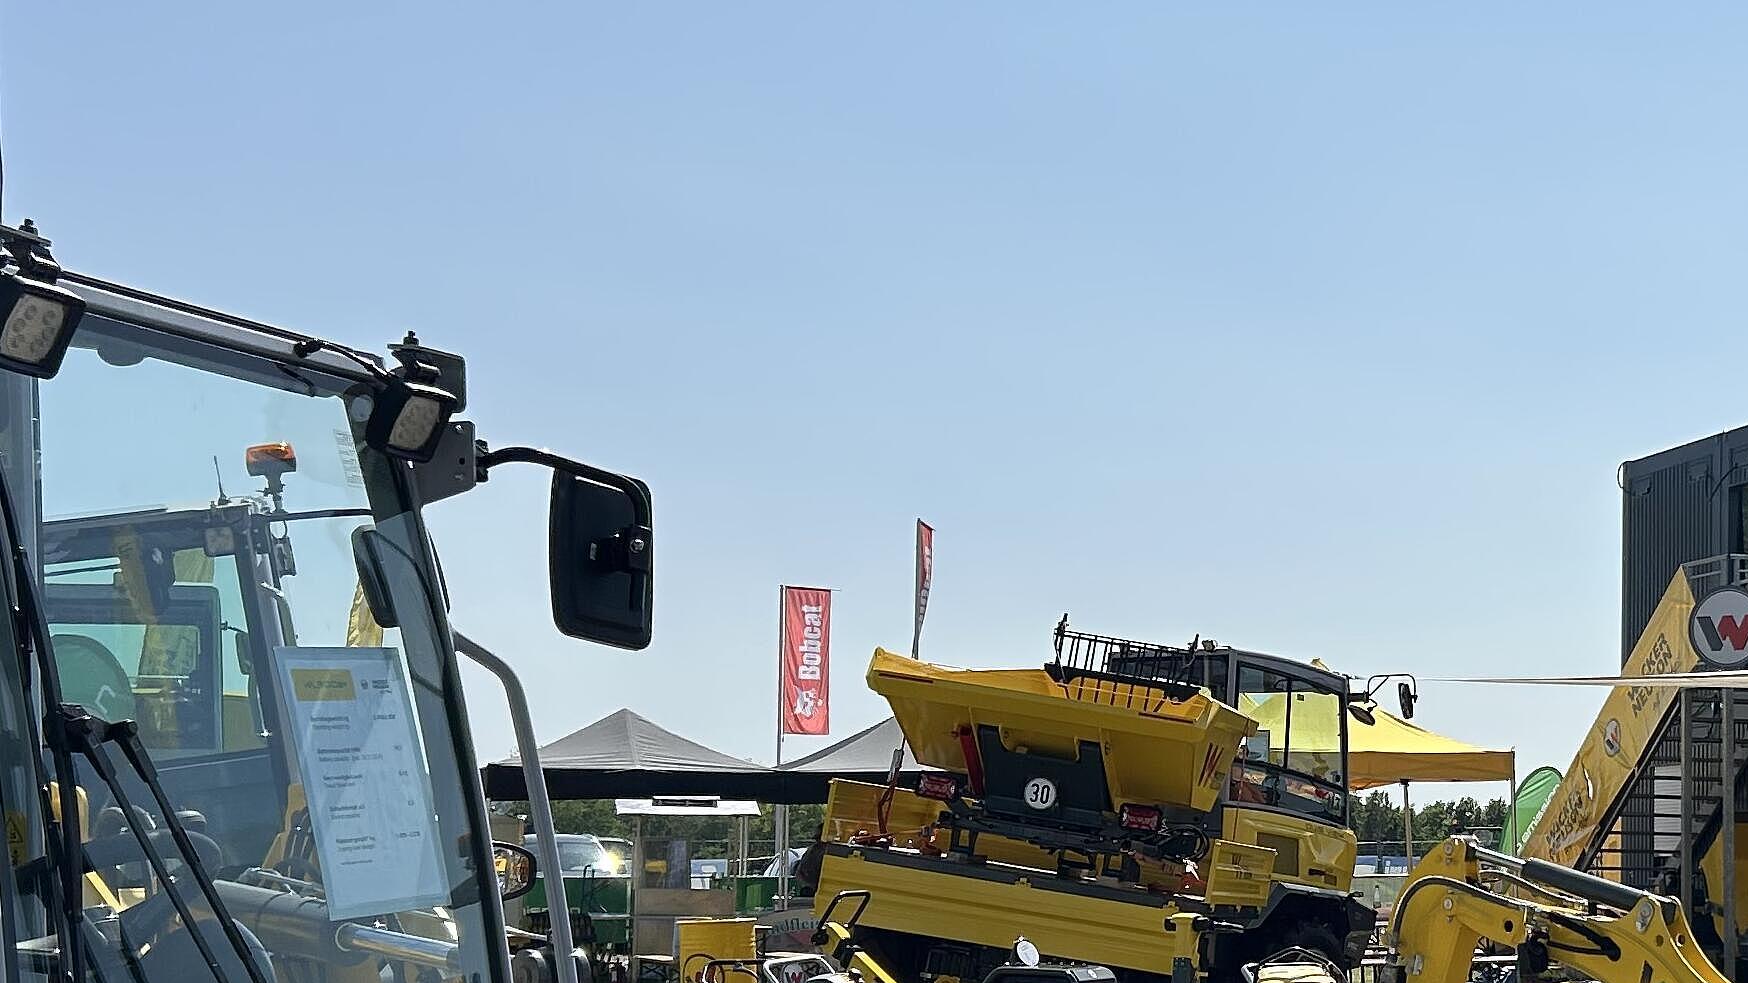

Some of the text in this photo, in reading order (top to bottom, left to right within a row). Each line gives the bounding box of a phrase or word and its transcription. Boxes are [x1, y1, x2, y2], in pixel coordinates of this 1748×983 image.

[798, 604, 822, 680] Bobcat
[1627, 633, 1668, 703] WCKER
[1630, 645, 1673, 718] NEUON
[1029, 782, 1051, 805] 30
